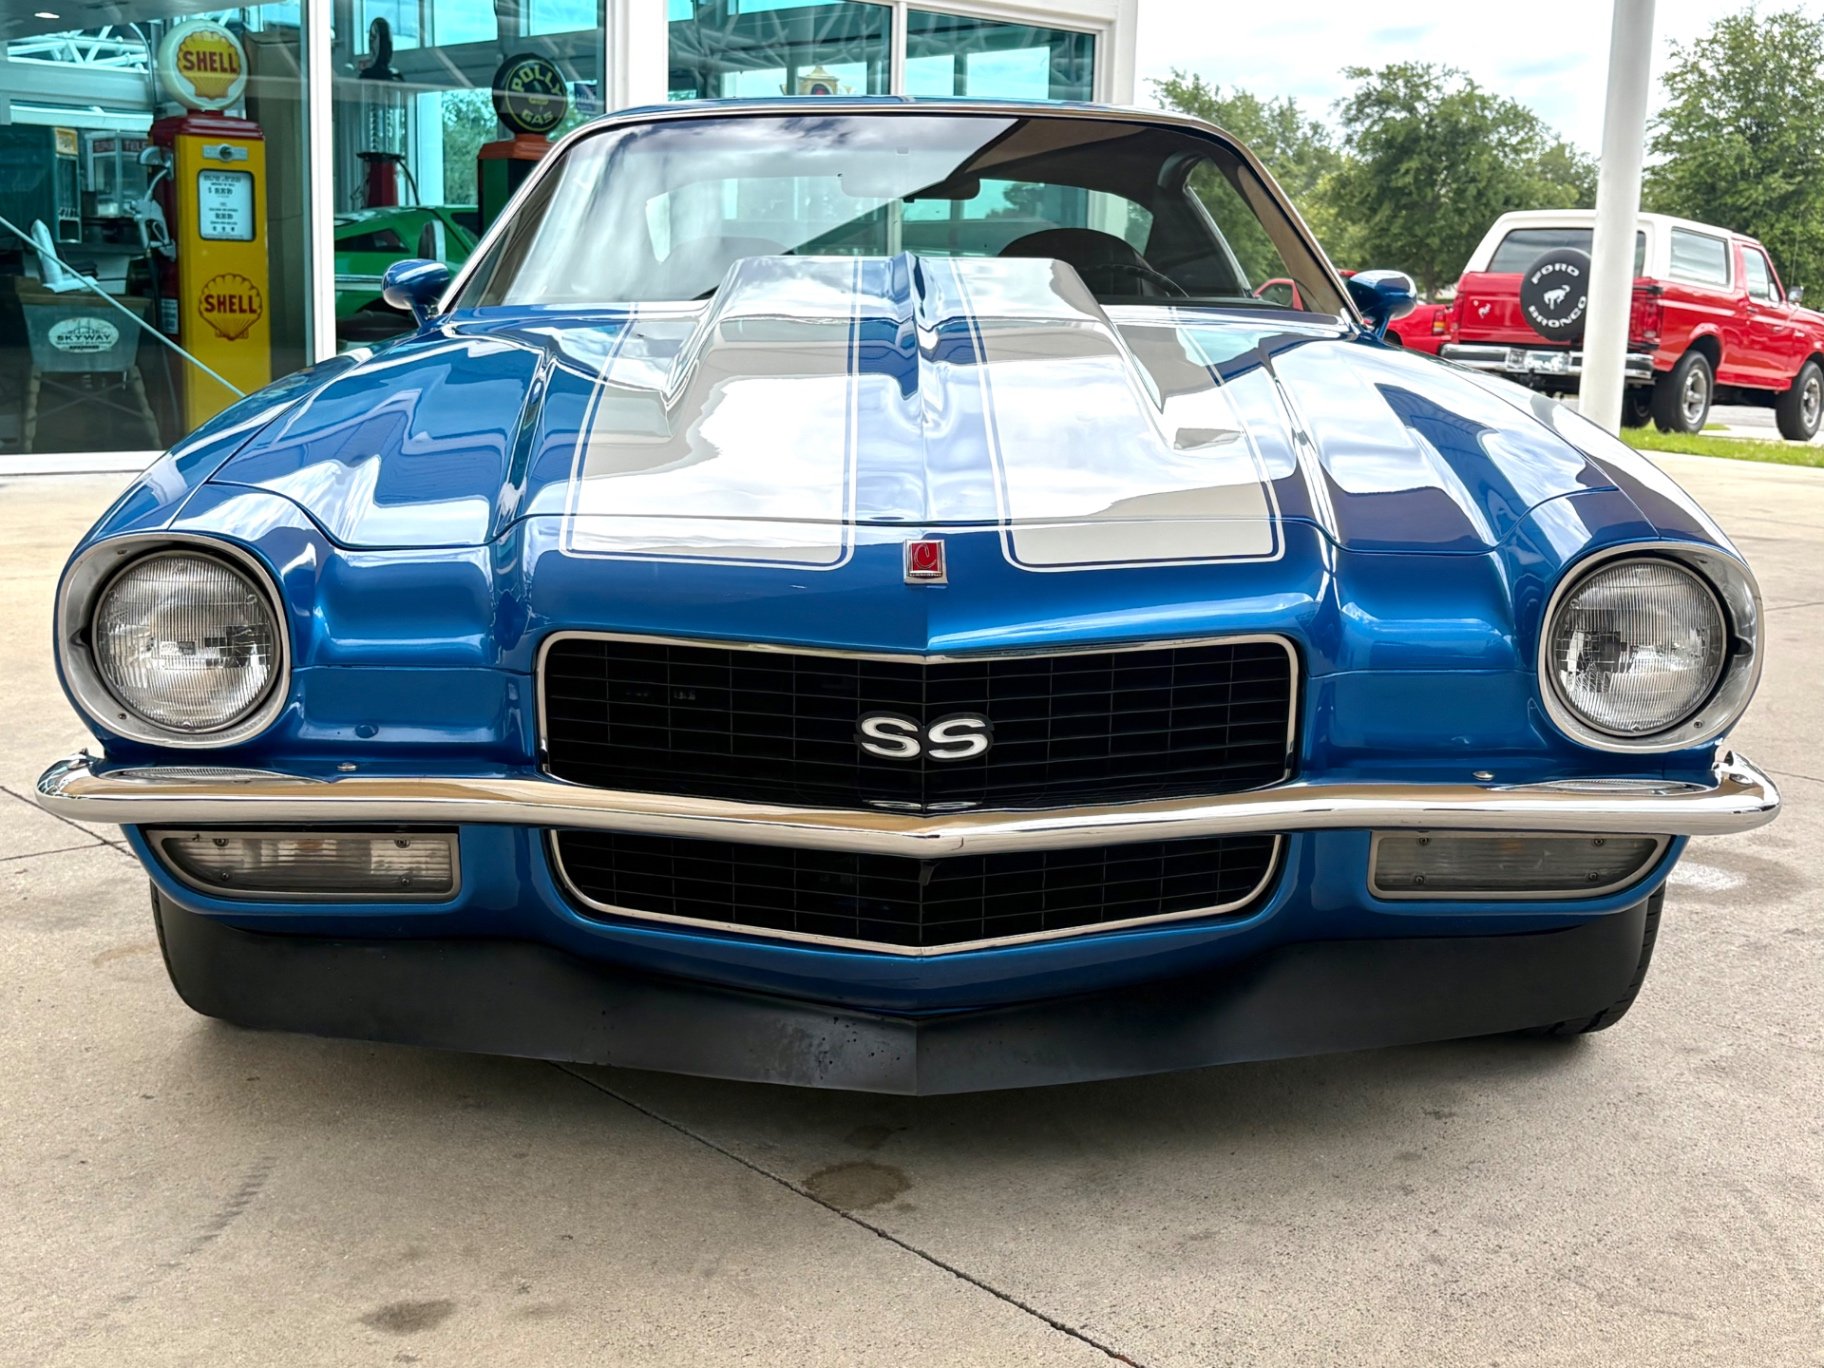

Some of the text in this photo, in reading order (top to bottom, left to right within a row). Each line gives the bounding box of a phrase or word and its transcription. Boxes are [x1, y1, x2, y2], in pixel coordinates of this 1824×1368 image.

[183, 50, 238, 73] SHELL
[511, 65, 562, 95] POLLY
[522, 109, 553, 124] GAS
[1531, 263, 1579, 284] FORD
[204, 294, 257, 314] SHELL
[1528, 296, 1586, 328] BRONCO
[861, 716, 988, 759] SS
